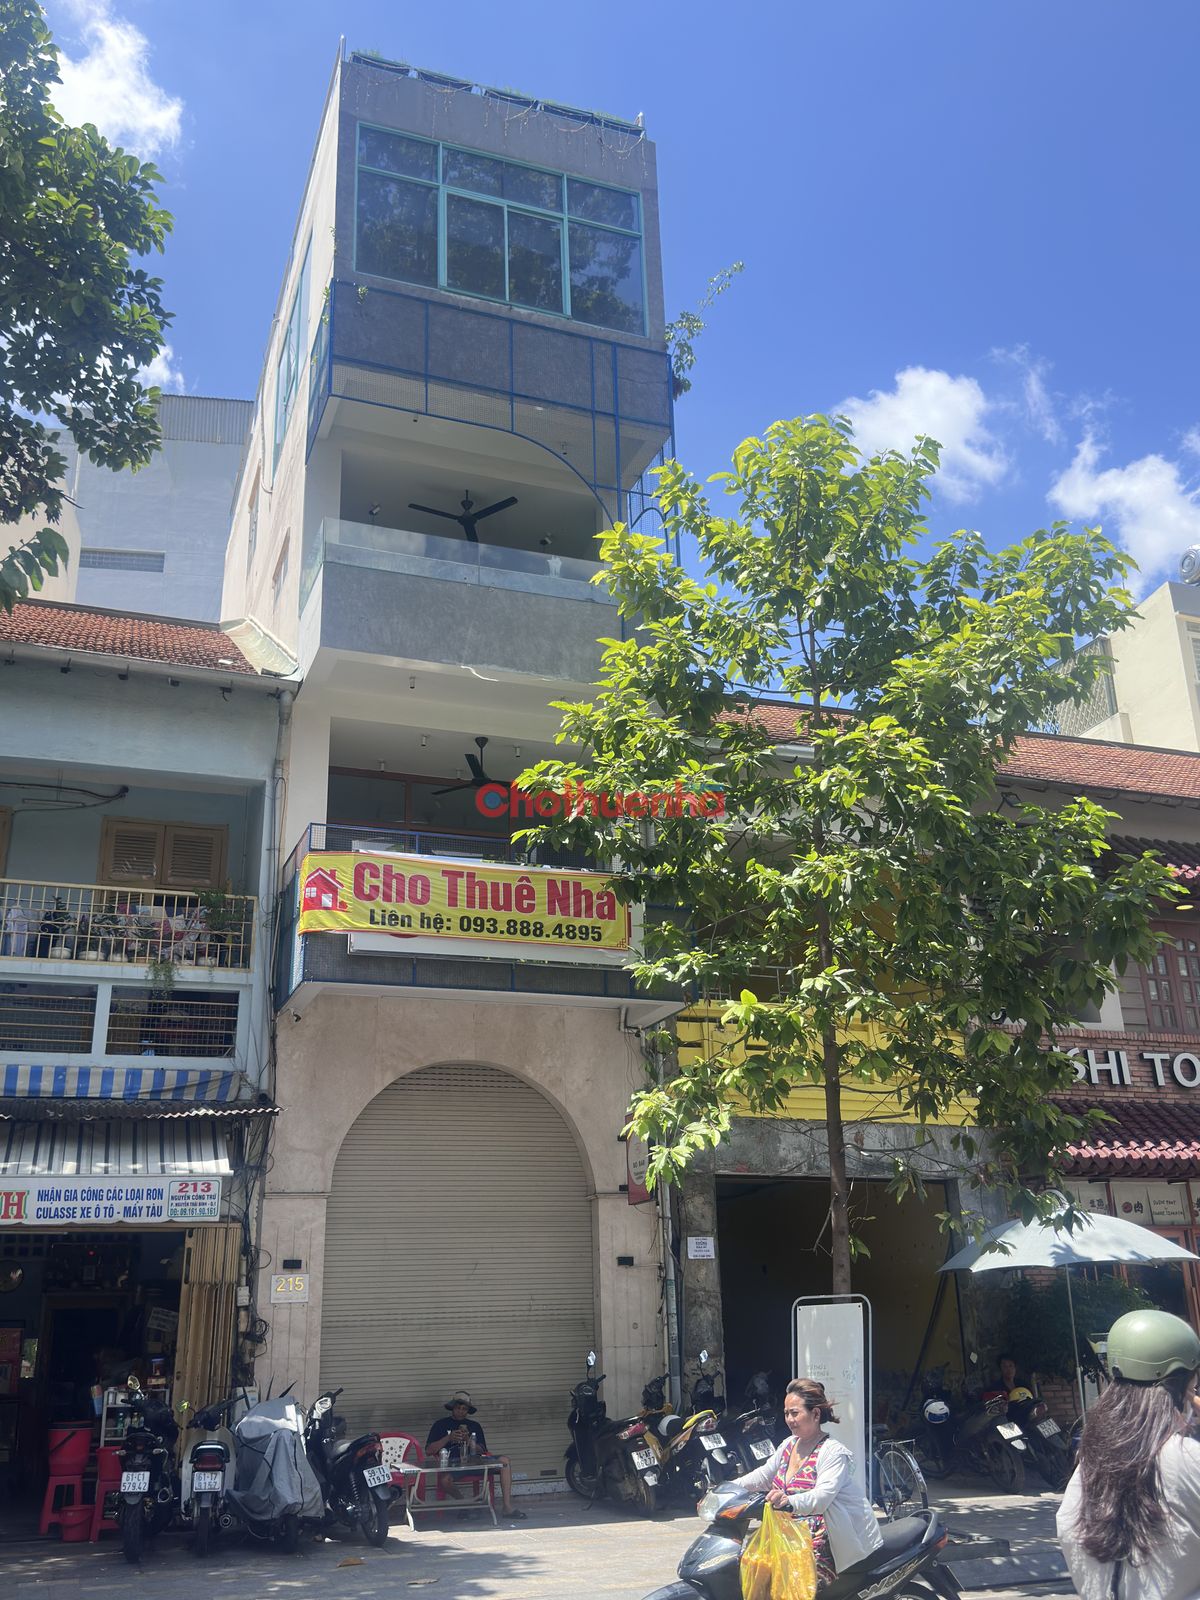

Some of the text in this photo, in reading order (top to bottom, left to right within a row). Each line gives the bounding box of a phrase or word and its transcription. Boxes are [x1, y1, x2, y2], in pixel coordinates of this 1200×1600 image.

[353, 861, 431, 906] Cho
[441, 869, 537, 914] Thuê
[369, 908, 602, 942] Liên hệ: 093.888.4895
[37, 1185, 164, 1204] NHẬN GIA CÔNG CÁC LOẠI RON
[178, 1181, 212, 1193] 213
[36, 1206, 77, 1219] CULASSE
[80, 1206, 92, 1218] XE
[94, 1204, 100, 1218] Ô
[103, 1204, 114, 1218] TÔ
[123, 1202, 143, 1218] MÁY
[146, 1203, 163, 1217] TÀU
[276, 1276, 305, 1292] 215
[125, 1473, 145, 1482] 61-C1
[122, 1482, 147, 1491] 579.42
